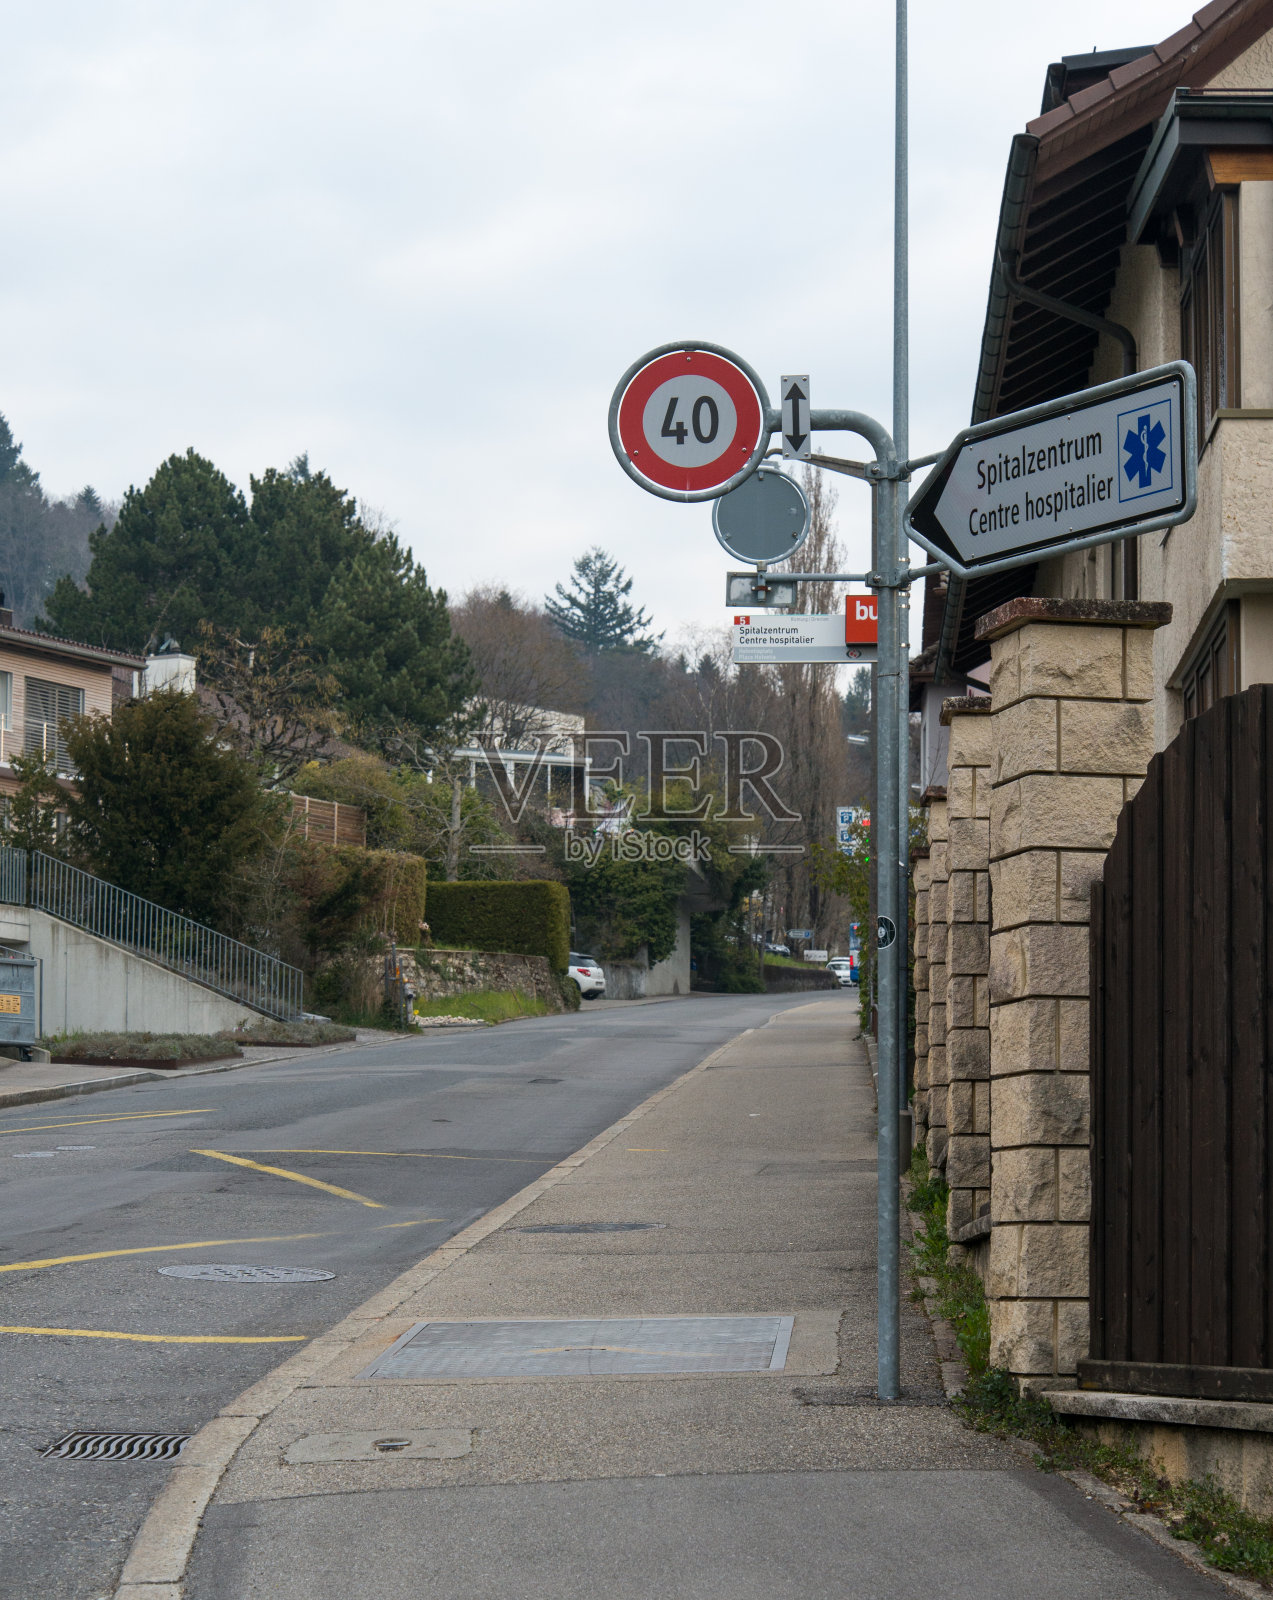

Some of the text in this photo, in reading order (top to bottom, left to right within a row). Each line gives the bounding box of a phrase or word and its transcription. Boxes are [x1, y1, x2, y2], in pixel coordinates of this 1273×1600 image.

[661, 396, 719, 445] 40
[977, 432, 1102, 494] Spitalzentrum
[968, 474, 1114, 537] Centre hospitalier
[739, 616, 746, 626] 5
[855, 600, 878, 621] bu
[739, 626, 799, 636] Spitalzentrum
[739, 636, 815, 645] Centre hospitalier
